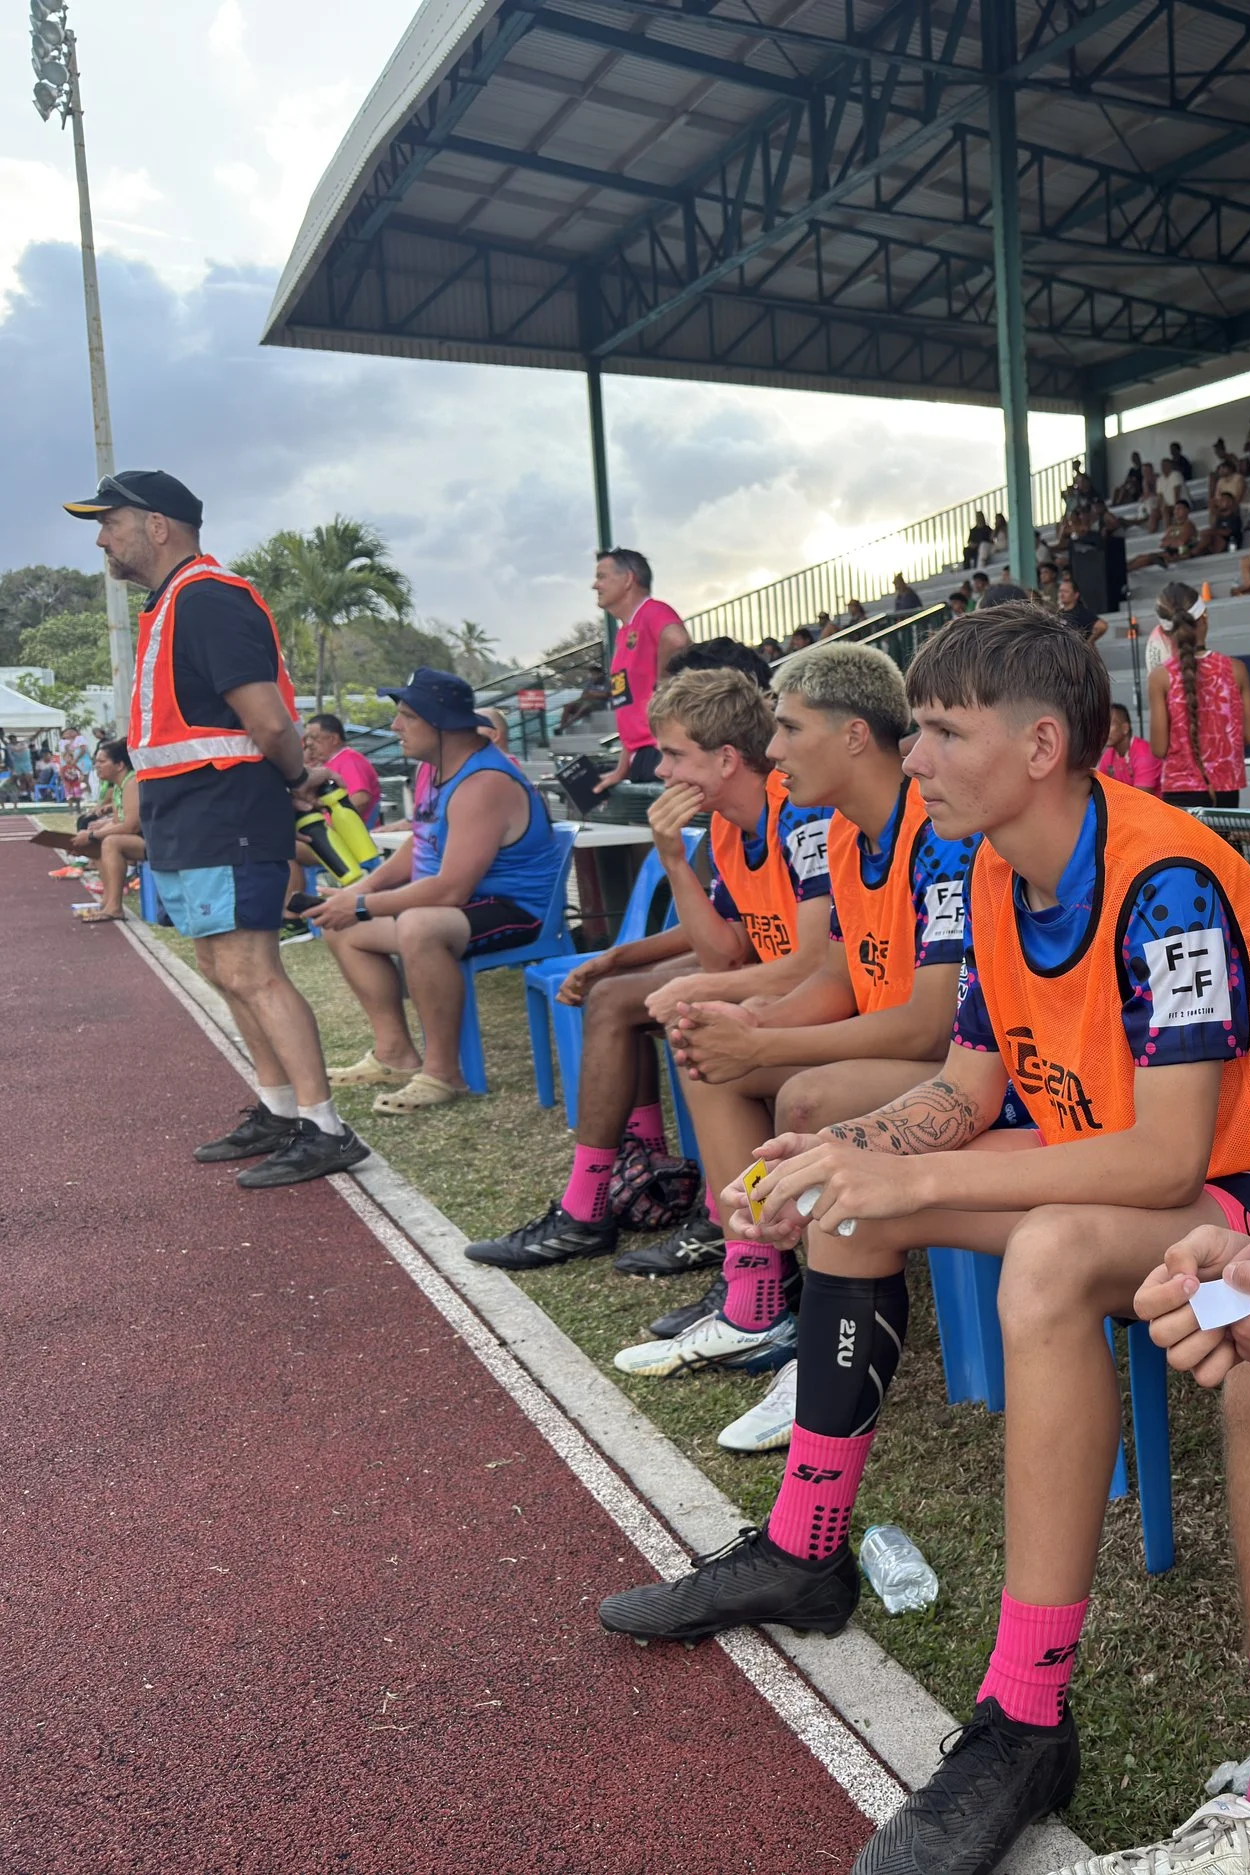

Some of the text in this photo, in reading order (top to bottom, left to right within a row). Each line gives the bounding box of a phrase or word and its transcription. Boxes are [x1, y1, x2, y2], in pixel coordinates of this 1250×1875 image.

[735, 1256, 769, 1269] SP
[837, 1318, 856, 1368] 2XU
[791, 1463, 843, 1484] SP
[1034, 1641, 1080, 1667] SP
